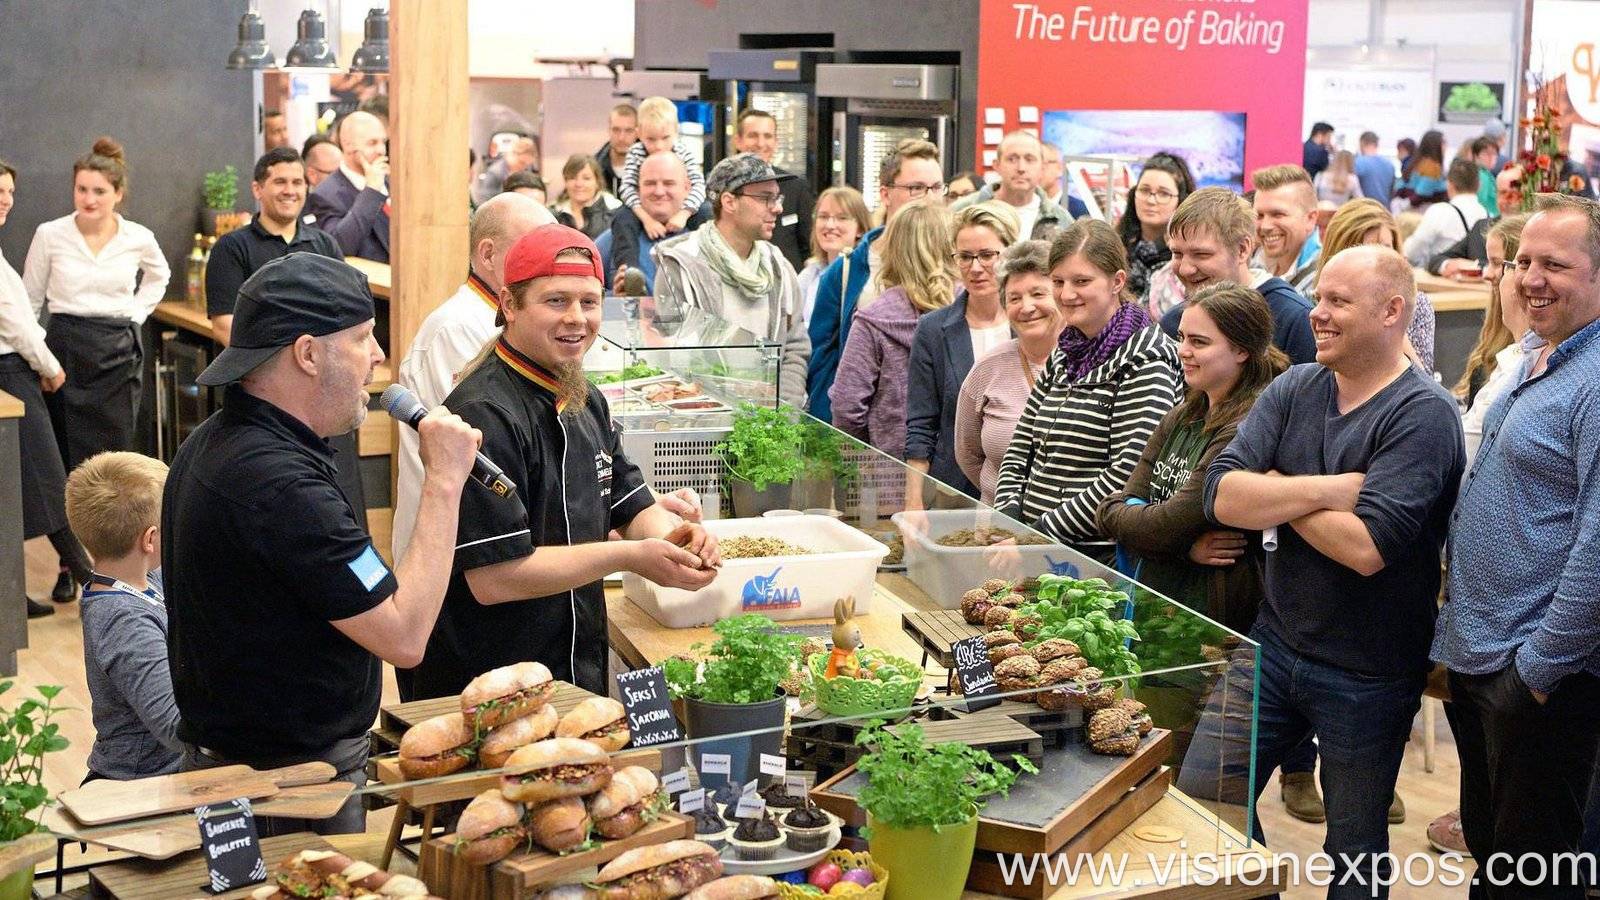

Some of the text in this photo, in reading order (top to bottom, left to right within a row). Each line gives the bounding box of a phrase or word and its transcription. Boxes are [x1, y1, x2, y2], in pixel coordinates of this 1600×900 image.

[1013, 4, 1285, 54] The Future of Baking
